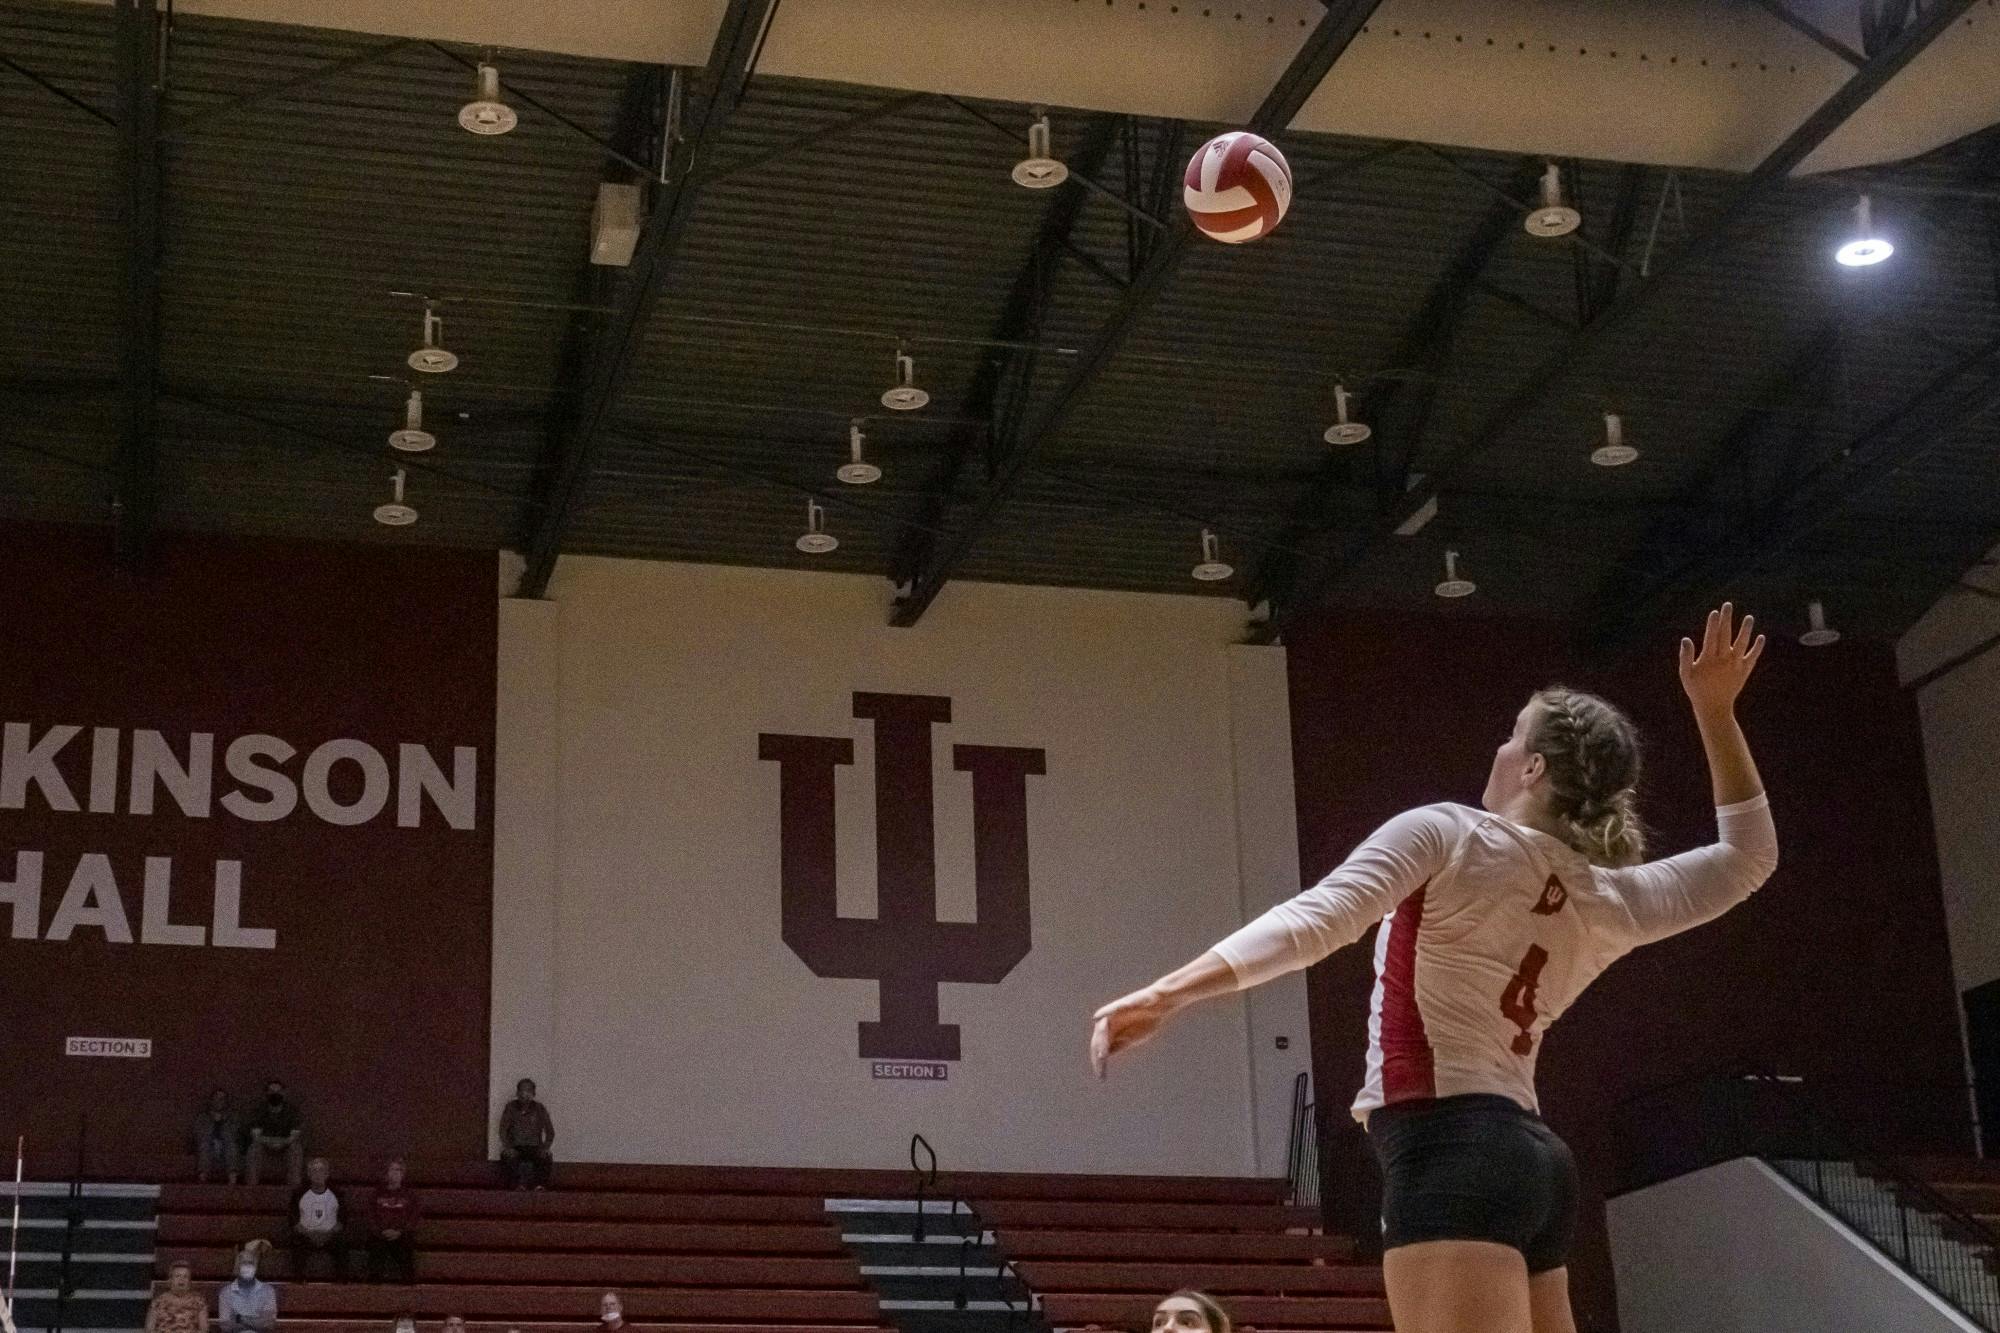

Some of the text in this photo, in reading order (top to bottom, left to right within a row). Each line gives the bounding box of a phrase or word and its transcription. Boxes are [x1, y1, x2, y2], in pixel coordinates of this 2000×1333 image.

[1500, 943, 1549, 1057] 4
[69, 1040, 148, 1054] SECTION 3
[874, 1064, 946, 1078] SECTION 3
